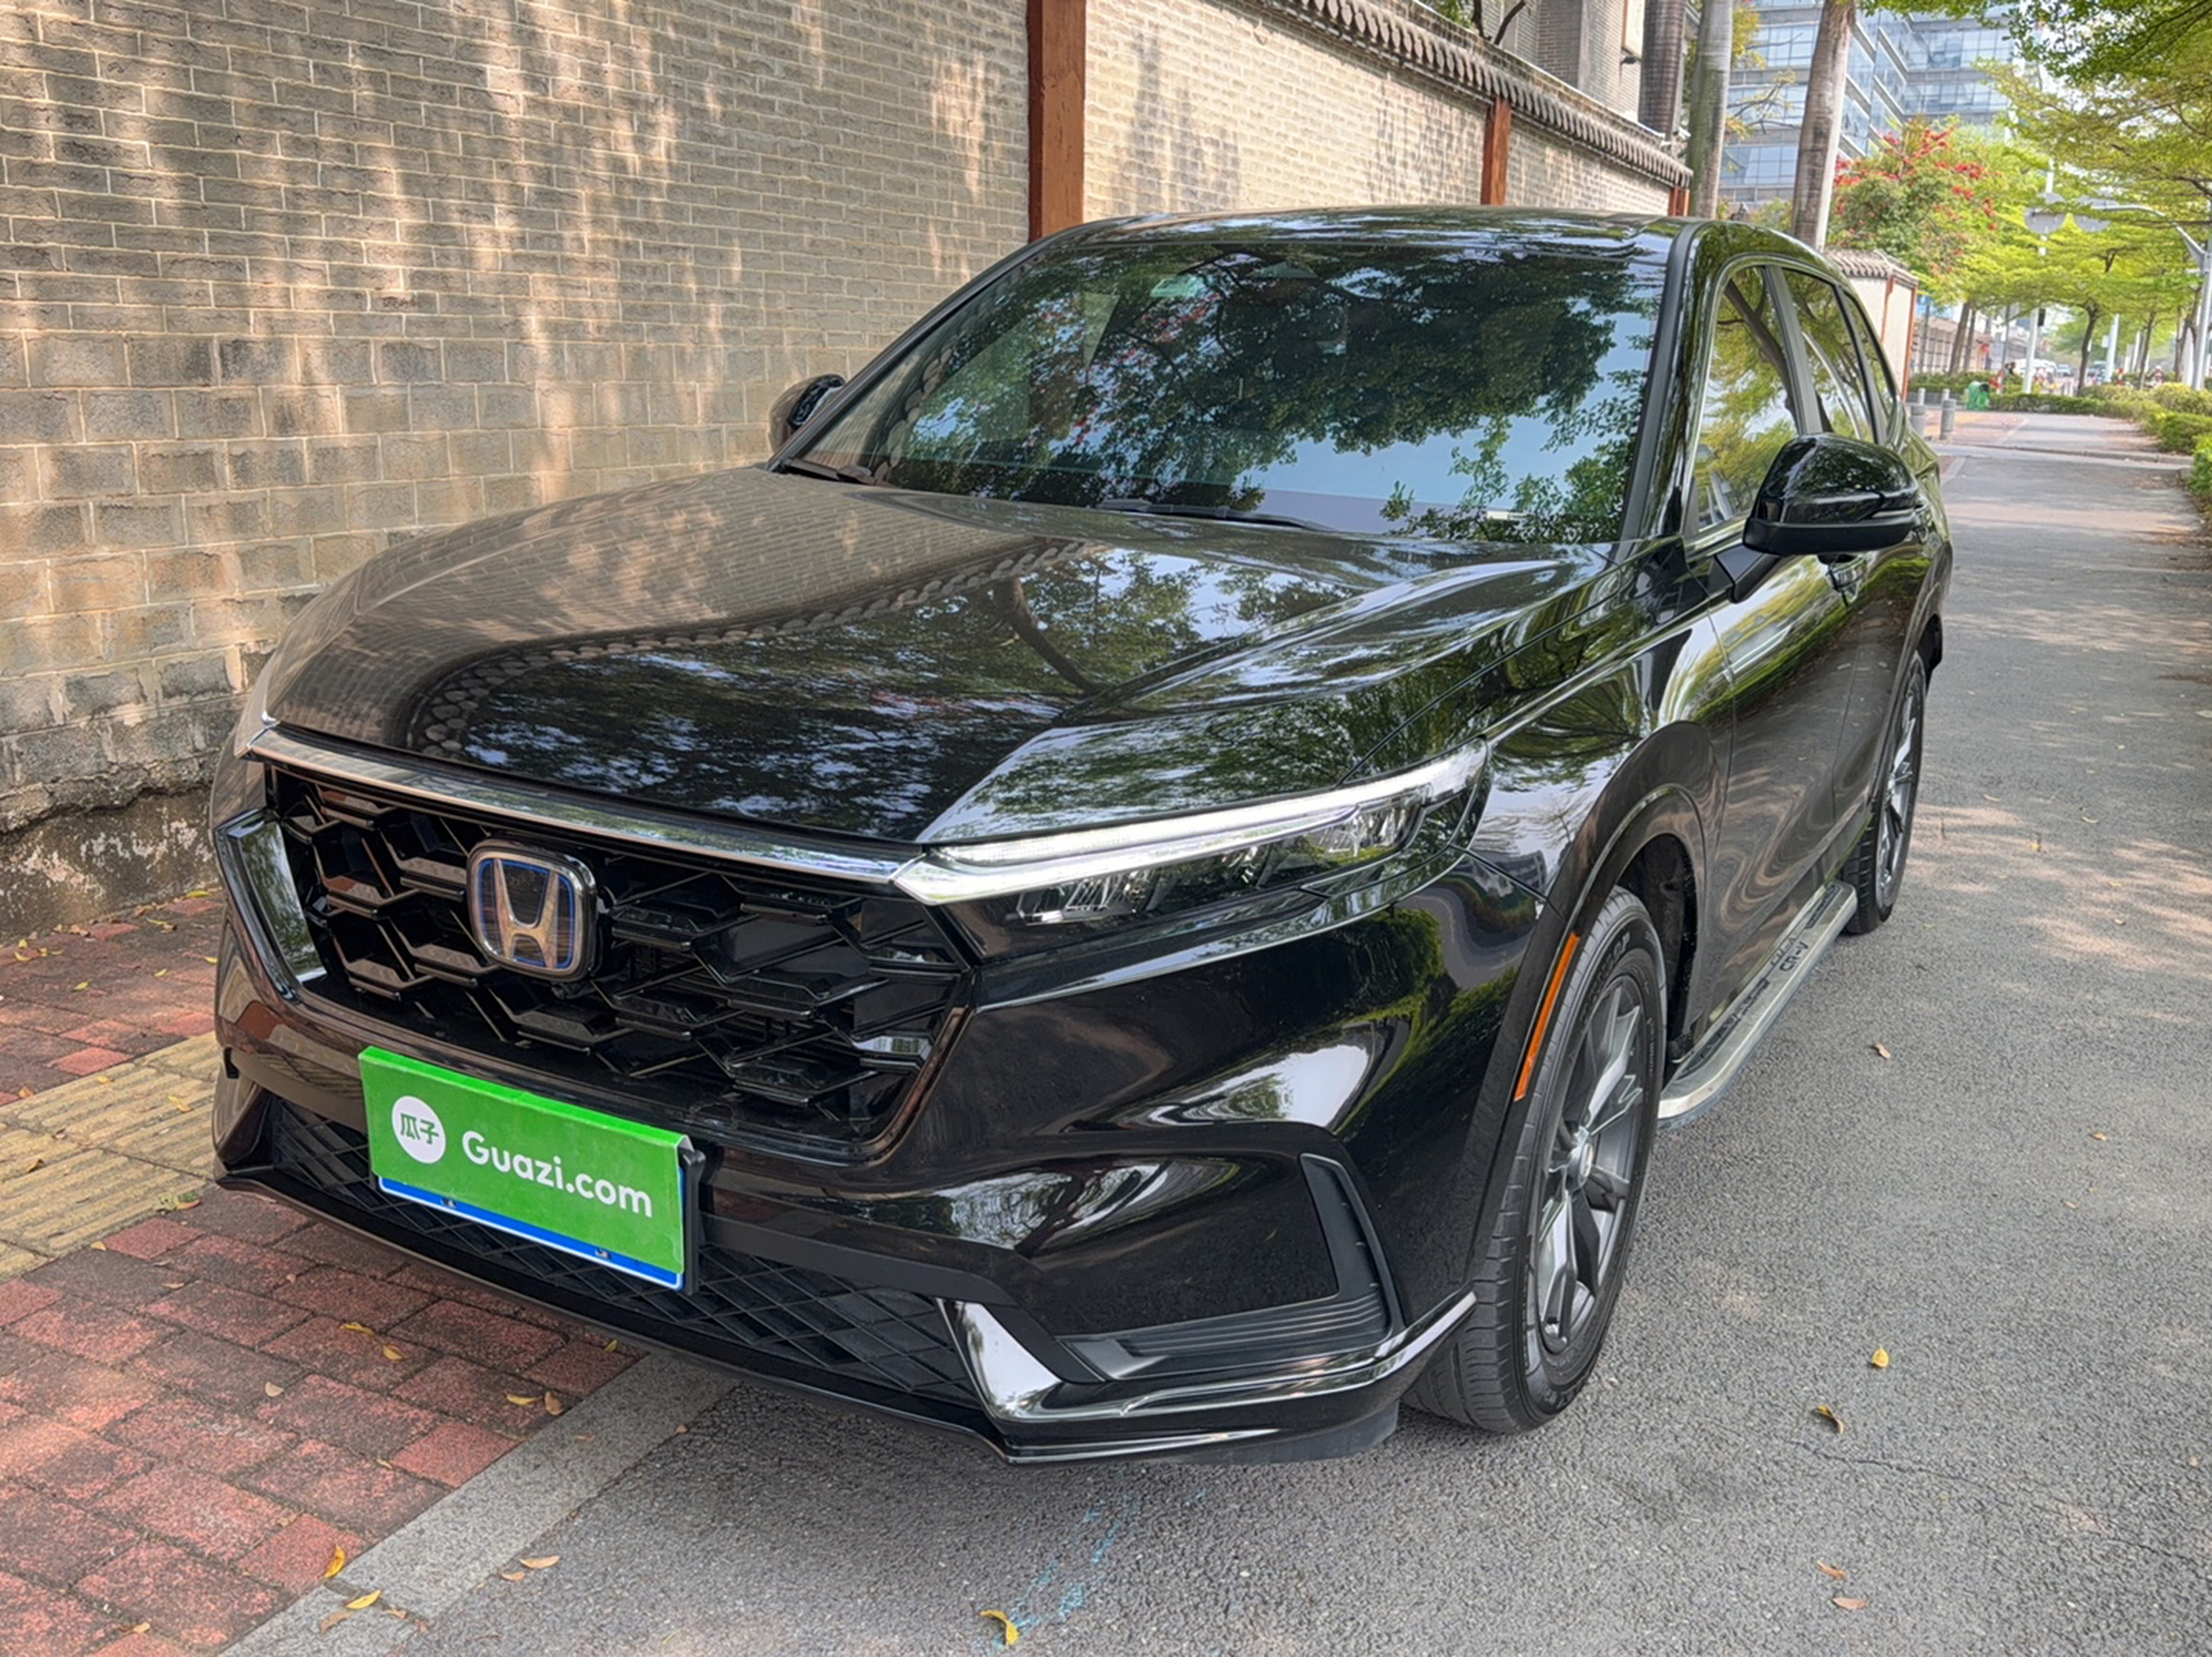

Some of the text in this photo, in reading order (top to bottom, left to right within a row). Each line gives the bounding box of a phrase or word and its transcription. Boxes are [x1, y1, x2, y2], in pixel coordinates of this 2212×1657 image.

[1779, 941, 1808, 971] CR-V
[400, 1113, 439, 1145] 瓜子
[462, 1130, 652, 1217] Guazi.com
